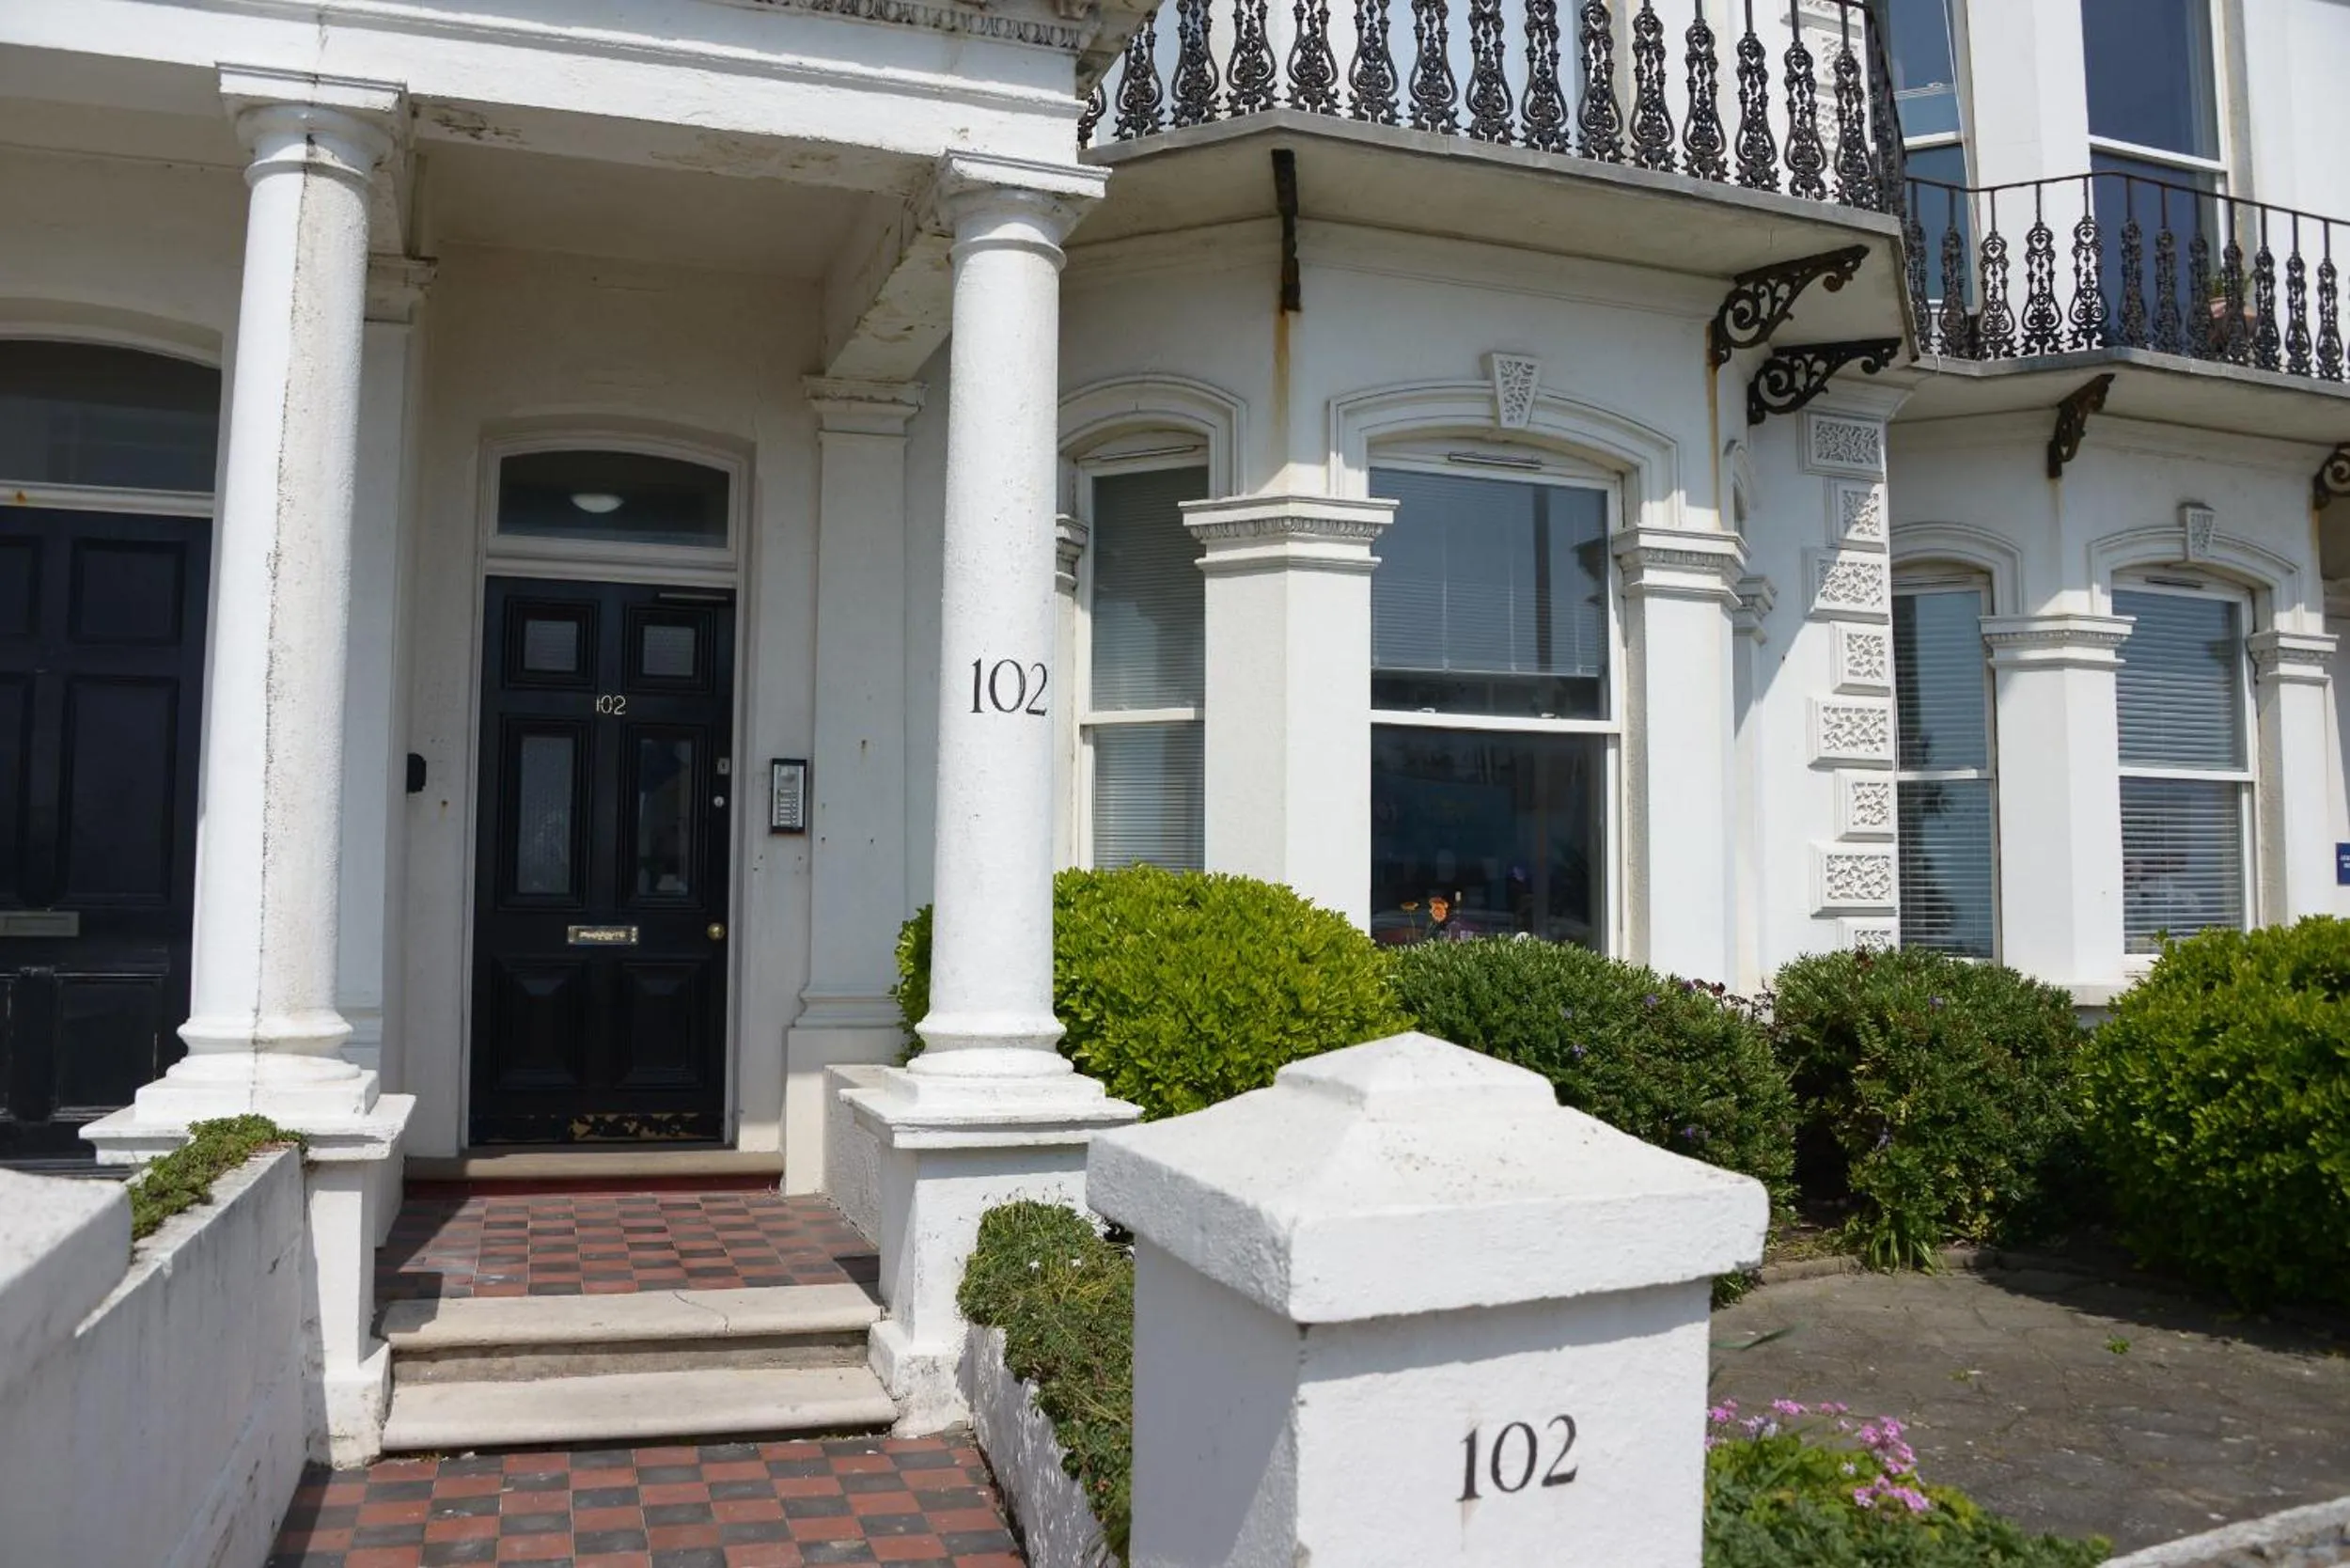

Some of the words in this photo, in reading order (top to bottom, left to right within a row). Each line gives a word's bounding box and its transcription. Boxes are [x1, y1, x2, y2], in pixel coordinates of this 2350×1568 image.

[596, 695, 626, 714] 102
[970, 657, 1047, 715] 102
[1456, 1414, 1578, 1502] 102
